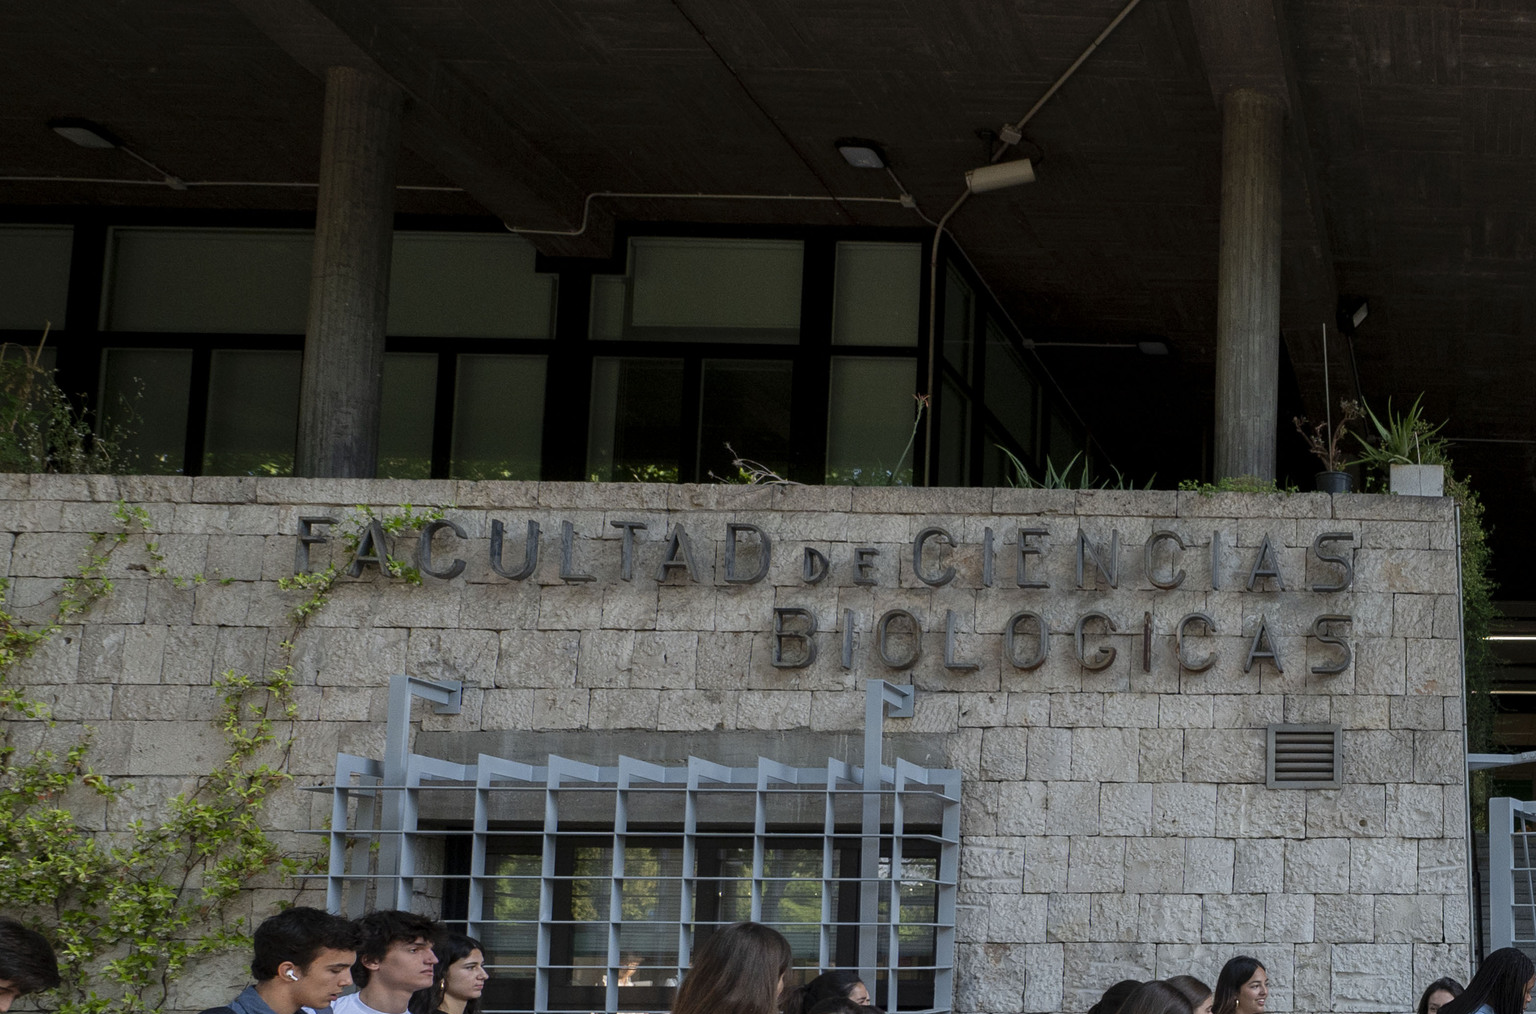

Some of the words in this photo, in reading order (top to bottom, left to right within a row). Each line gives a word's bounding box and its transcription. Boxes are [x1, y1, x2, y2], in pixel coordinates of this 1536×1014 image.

[294, 516, 772, 585] FACULTAD
[803, 546, 881, 586] DE
[912, 526, 1354, 592] CIENCIAS
[771, 607, 1353, 675] BIOLOGICAS
